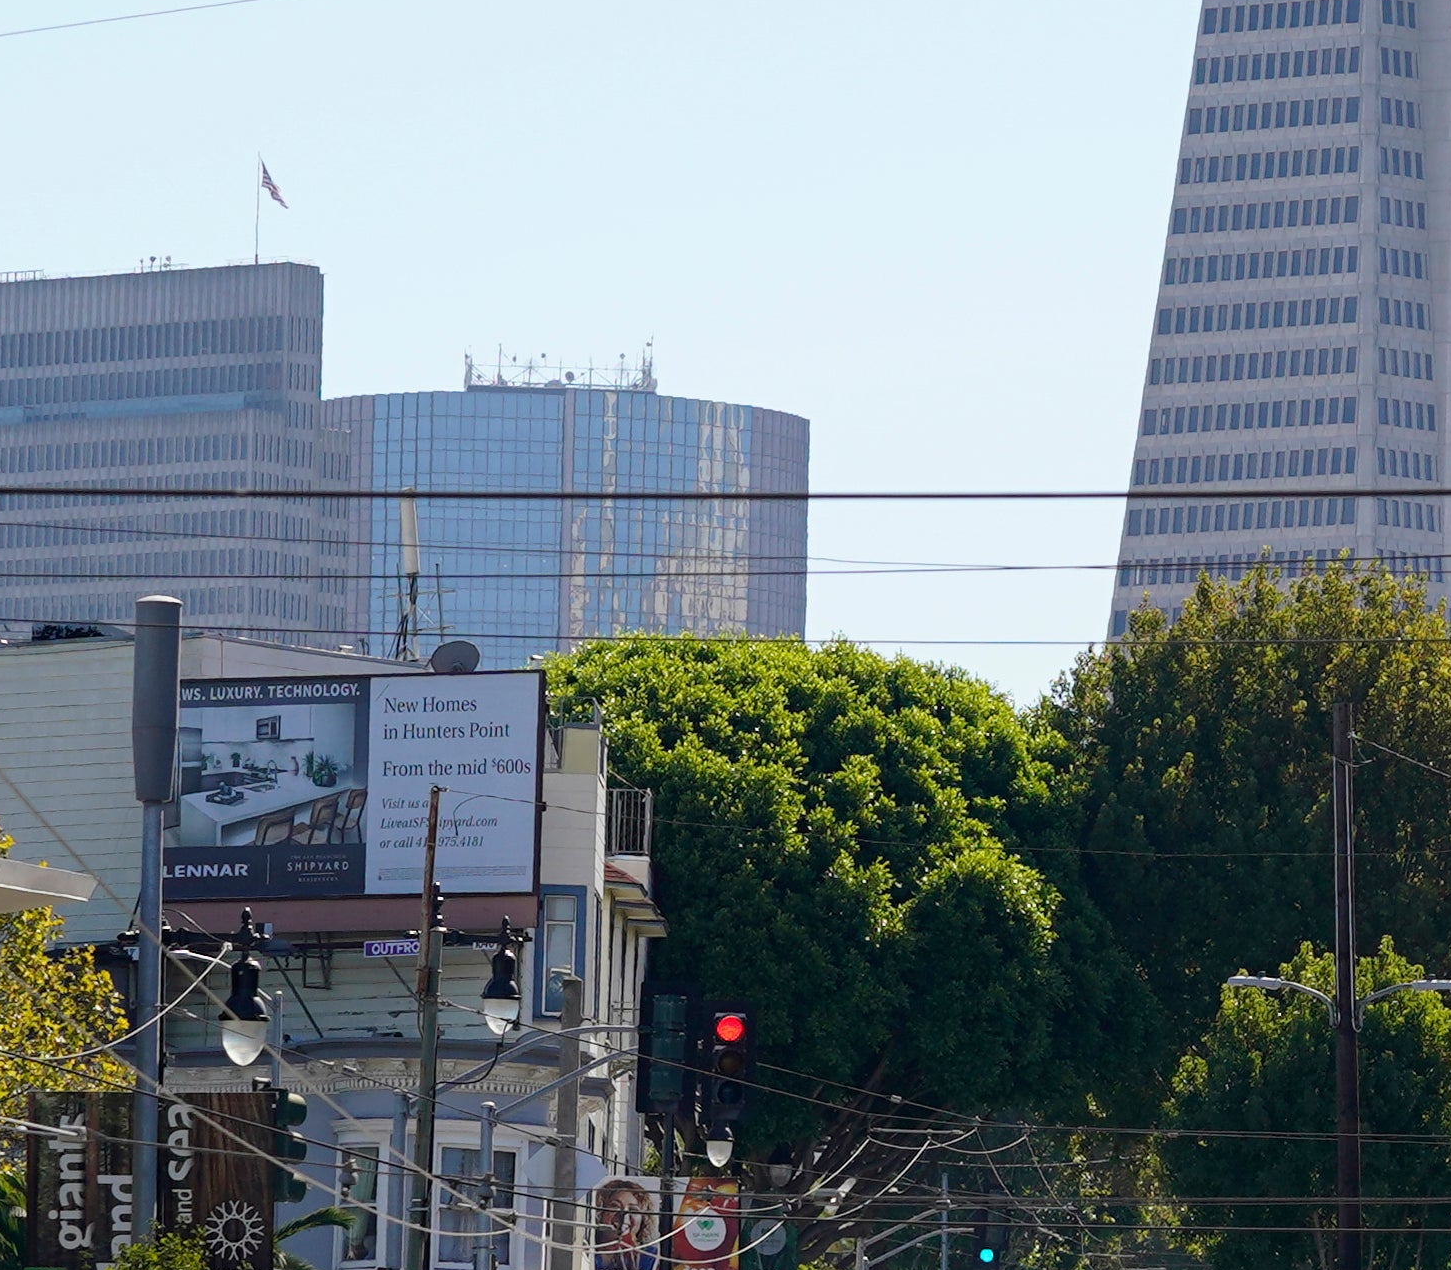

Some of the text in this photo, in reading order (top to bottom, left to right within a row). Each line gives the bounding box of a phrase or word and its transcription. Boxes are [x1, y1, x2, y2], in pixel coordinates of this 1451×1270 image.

[210, 684, 263, 701] LUXURY.
[268, 682, 360, 699] TECHNOLOGY.
[384, 695, 477, 713] New Homes
[384, 722, 510, 740] in Hunters Point
[383, 756, 531, 777] From the mid $600s
[381, 797, 423, 809] Visit us
[379, 836, 413, 849] or call
[163, 863, 249, 879] LENNAR
[287, 860, 350, 873] SHIPYARD
[167, 1103, 195, 1225] and sea
[48, 1114, 95, 1250] giants
